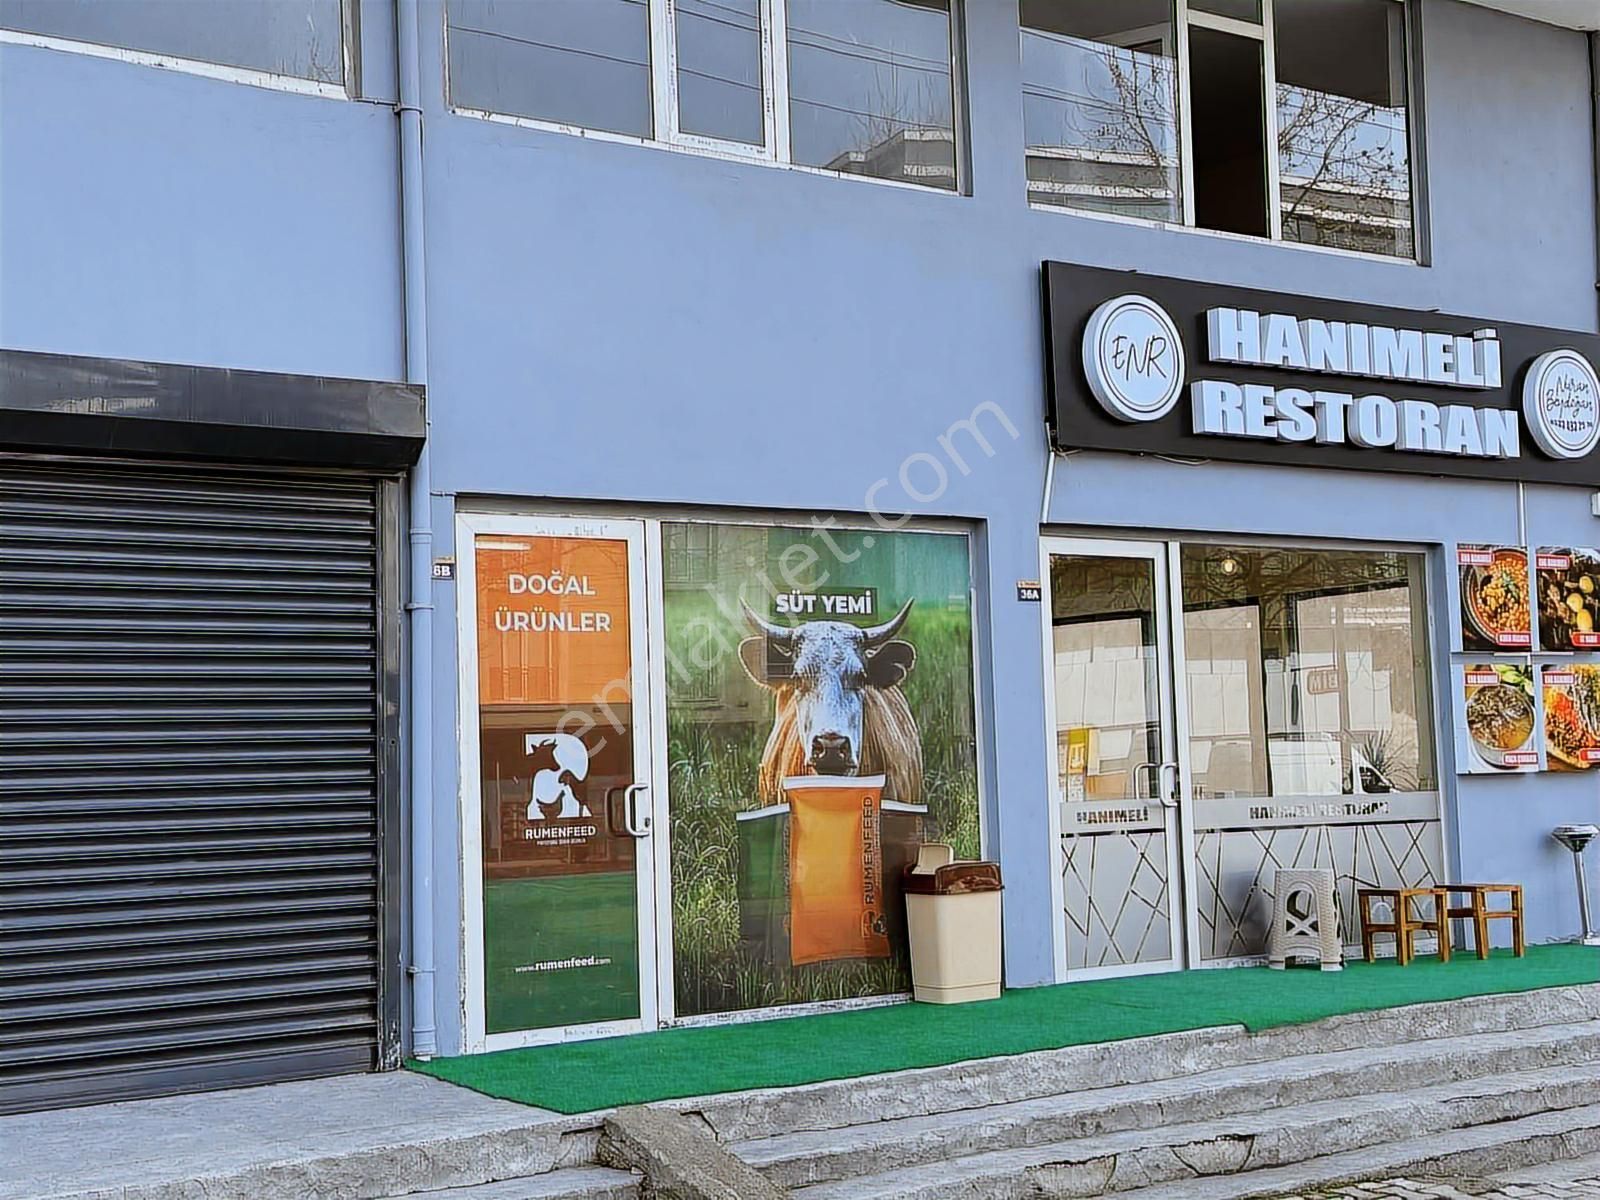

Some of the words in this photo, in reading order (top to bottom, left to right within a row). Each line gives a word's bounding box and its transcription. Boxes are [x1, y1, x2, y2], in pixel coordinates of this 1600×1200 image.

[1111, 332, 1168, 380] ENR
[1206, 306, 1502, 388] HANIMELİ
[1191, 380, 1522, 458] RESTORAN
[508, 569, 596, 596] DOĞAL
[775, 589, 817, 613] SÜT
[821, 590, 872, 614] YEMİ
[495, 606, 611, 632] ÜRÜNLER
[525, 825, 596, 840] RUMENFEED
[863, 796, 875, 905] RUMENFEED
[515, 955, 612, 973] www.rumenfeed.com
